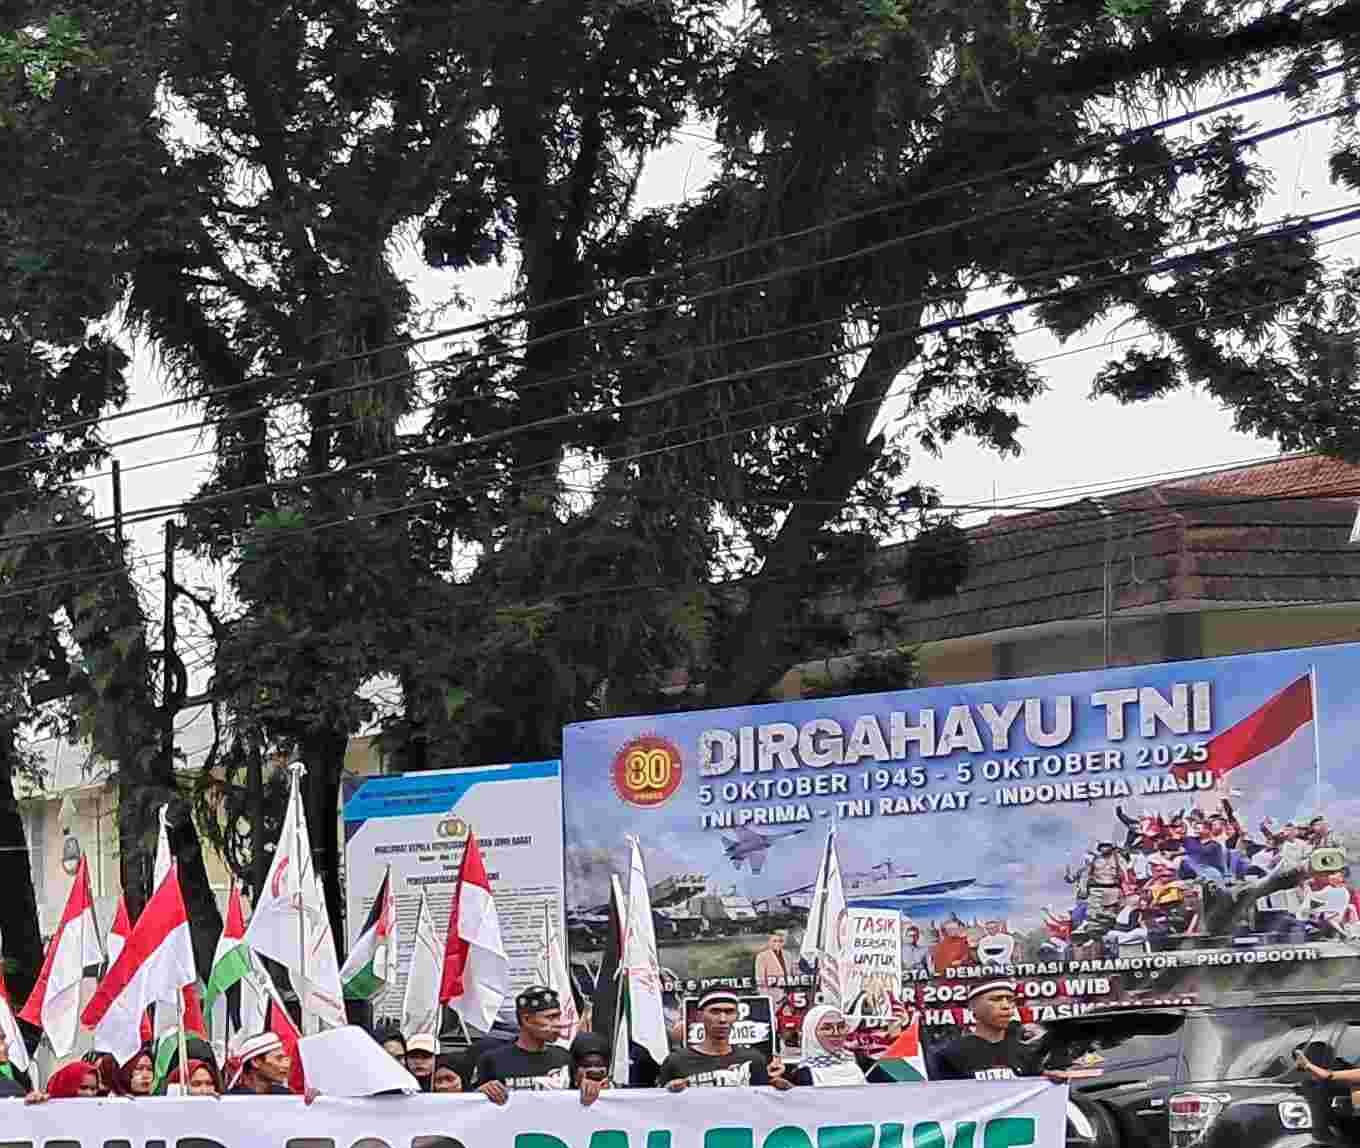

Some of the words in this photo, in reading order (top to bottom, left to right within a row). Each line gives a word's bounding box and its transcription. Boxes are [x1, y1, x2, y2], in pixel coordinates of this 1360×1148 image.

[699, 696, 1073, 777] DIRGAHAYU
[1091, 681, 1212, 741] TNI
[624, 748, 671, 790] 80
[699, 786, 712, 804] 5
[722, 774, 848, 801] OKTOBER
[862, 767, 925, 791] 1945
[958, 761, 972, 783] 5
[983, 750, 1122, 780] OKTOBER
[1136, 741, 1209, 768] 2025
[700, 812, 731, 830] TNI
[734, 804, 811, 826] PRIMA
[836, 800, 871, 818] TNI
[880, 792, 969, 815] RAKYAT
[995, 779, 1129, 806] INDONESIA
[1141, 770, 1214, 793] MAJU
[946, 961, 1063, 979] DEMONSTRASI
[1070, 955, 1177, 972] PARAMOTOR
[1197, 949, 1317, 967] PHOTOBOOTH
[924, 985, 971, 1003] 202
[1065, 978, 1111, 997] WIB
